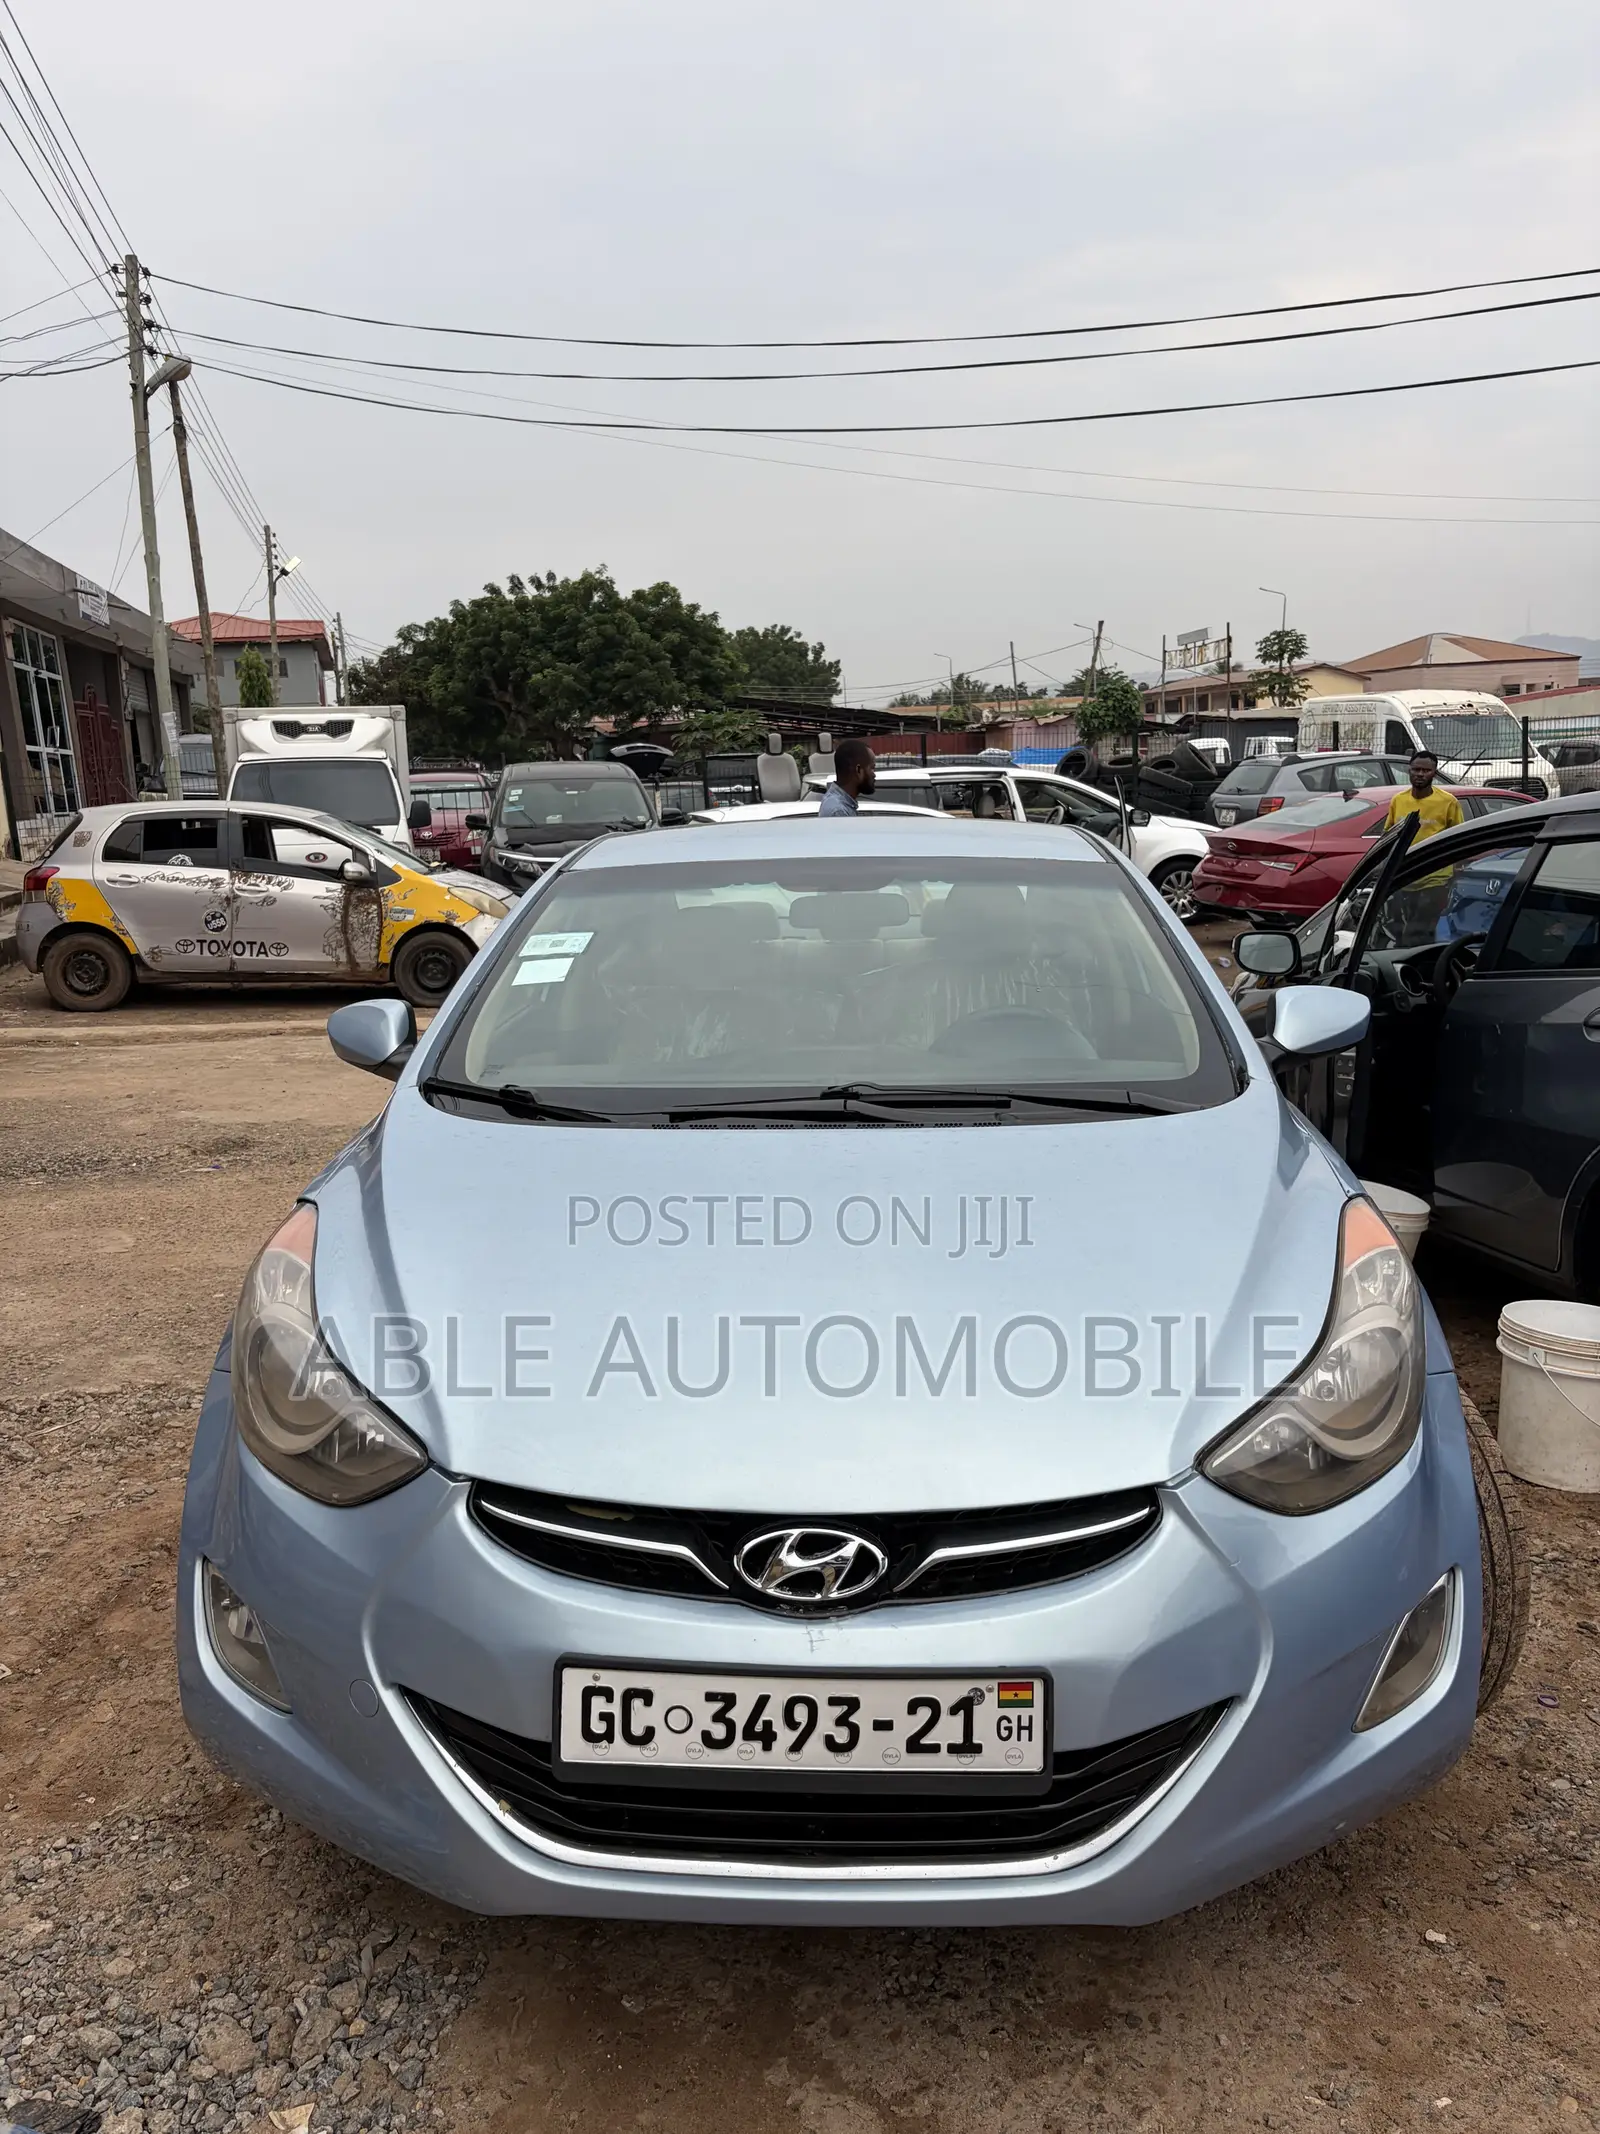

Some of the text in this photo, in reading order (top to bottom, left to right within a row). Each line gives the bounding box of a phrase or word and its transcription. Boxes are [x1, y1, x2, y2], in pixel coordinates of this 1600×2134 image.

[196, 940, 269, 958] TOYOTA
[581, 1685, 656, 1746] GC
[996, 1714, 1033, 1742] GH
